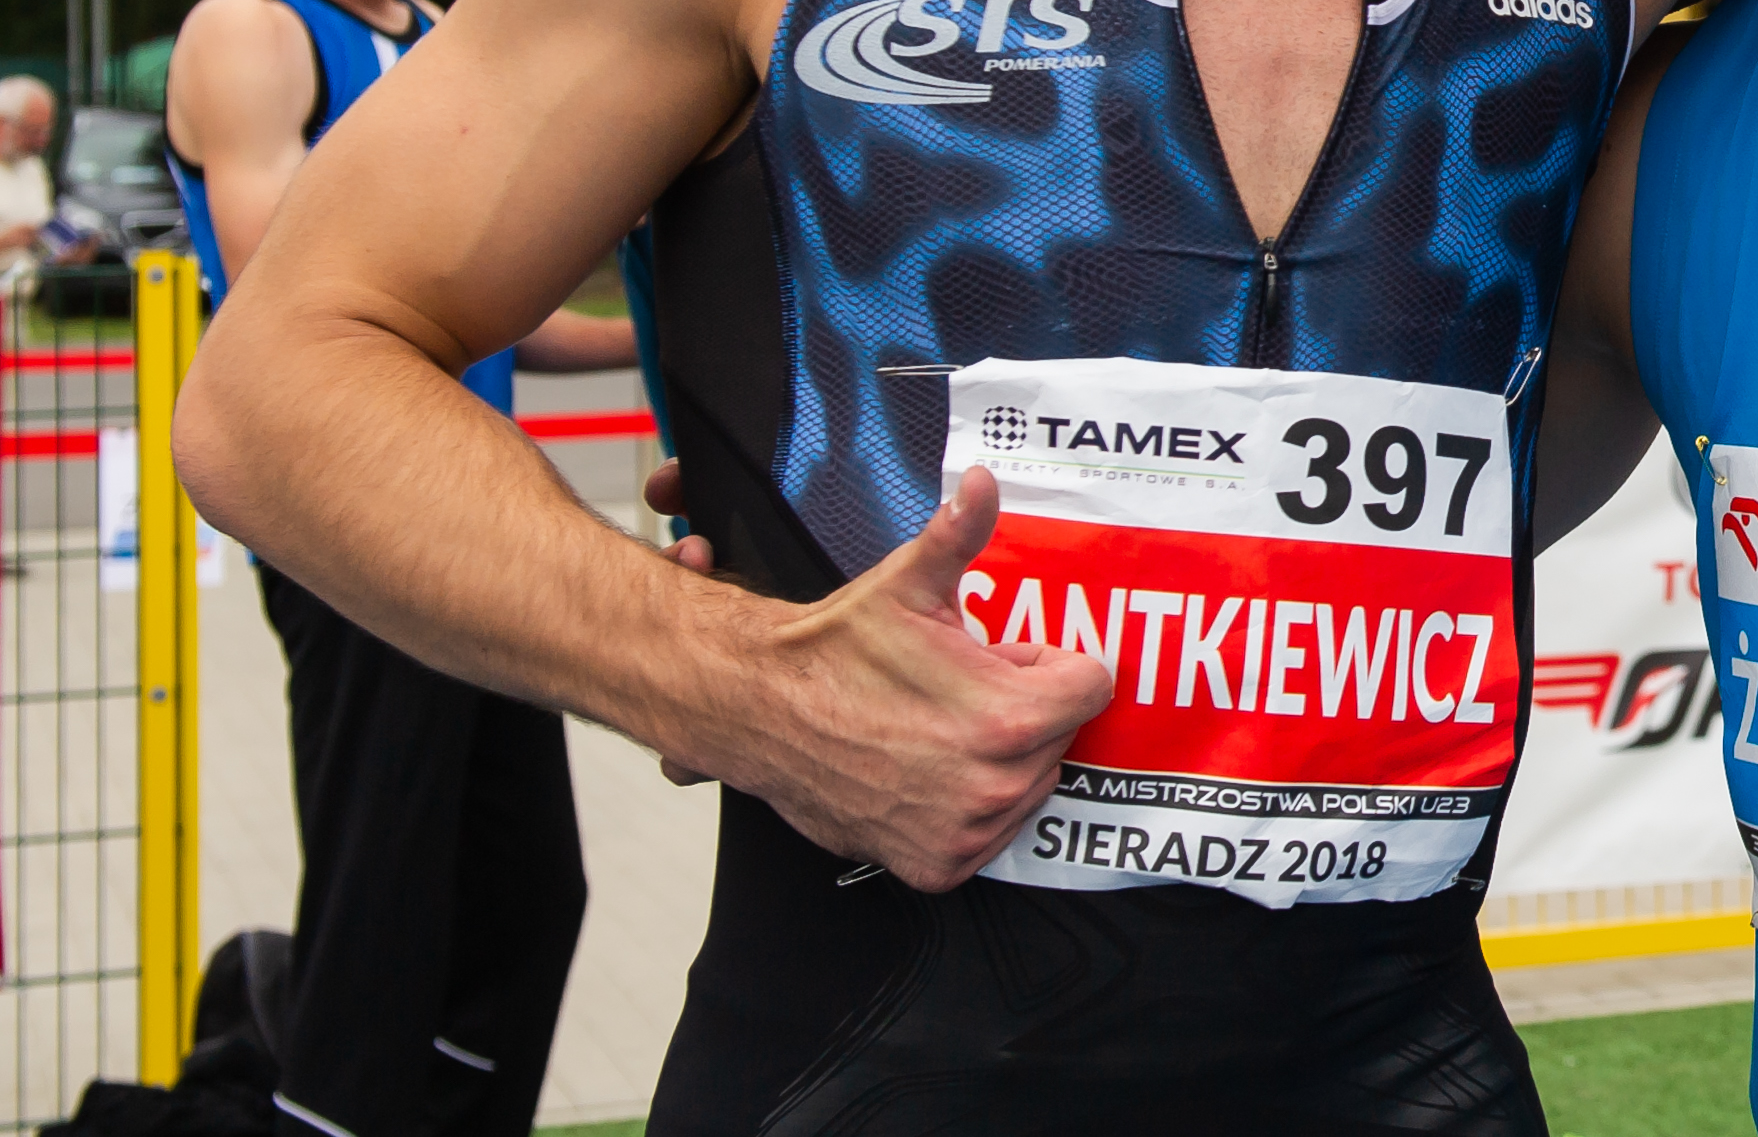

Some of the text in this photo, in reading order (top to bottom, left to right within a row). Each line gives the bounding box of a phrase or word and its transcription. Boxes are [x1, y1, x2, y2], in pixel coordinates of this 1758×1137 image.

[983, 54, 1107, 73] POMERANIA
[1036, 415, 1247, 464] TAMEX
[1079, 468, 1187, 487] SPORTOWE
[1276, 417, 1492, 536] 397
[1100, 777, 1315, 814] MISTRZOSTWA
[1322, 792, 1416, 816] POLSKI
[1420, 796, 1471, 815] U23
[1032, 815, 1388, 883] SIERADZ 2018
